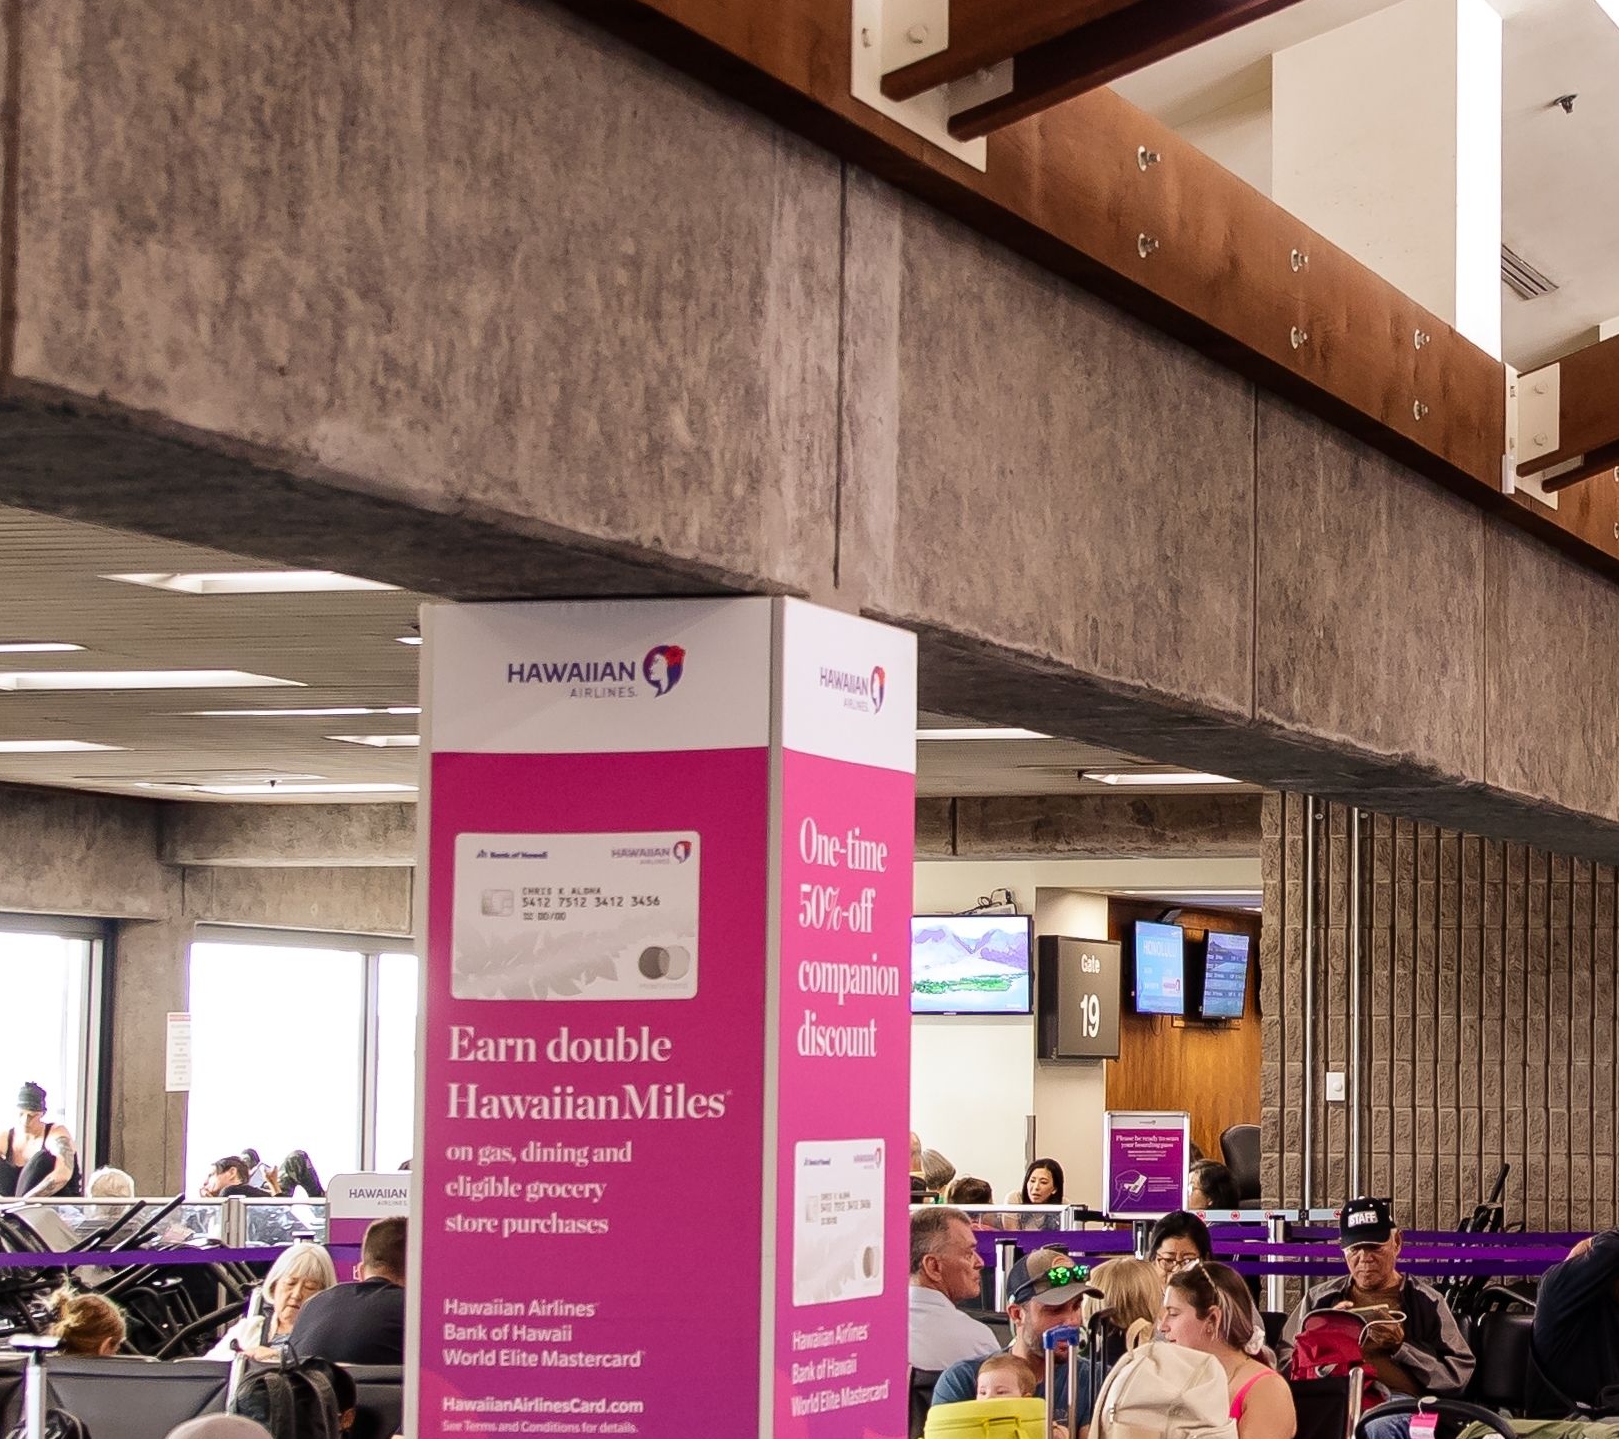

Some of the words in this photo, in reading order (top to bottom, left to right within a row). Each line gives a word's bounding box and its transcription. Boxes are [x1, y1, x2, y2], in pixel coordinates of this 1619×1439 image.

[507, 662, 636, 683] HAWAIIAN
[819, 666, 869, 696] HAWAIIAN
[570, 687, 636, 699] AIRLINES
[799, 817, 888, 873] One-time
[522, 897, 551, 907] 5412
[558, 897, 587, 907] 7512
[594, 896, 624, 907] 3412
[631, 896, 660, 907] 3456
[798, 883, 875, 933] 50%-off
[1081, 953, 1100, 974] Gate
[798, 954, 899, 1006] companion
[1080, 994, 1101, 1038] 19
[448, 1025, 537, 1062] Earn
[546, 1026, 673, 1063] double
[797, 1010, 877, 1058] discount
[445, 1145, 473, 1161] on
[478, 1145, 517, 1165] gas,
[521, 1141, 590, 1167] dining
[593, 1141, 632, 1162] and
[349, 1189, 407, 1198] HAWAIIAN
[445, 1176, 522, 1201] eligible
[526, 1182, 607, 1203] grocery
[445, 1213, 498, 1233] store
[502, 1213, 609, 1238] purchases
[1348, 1209, 1379, 1229] STAFF
[443, 1299, 524, 1316] Hawaiian
[528, 1299, 596, 1317] Airlines
[443, 1323, 488, 1341] Bank
[490, 1324, 511, 1341] of
[512, 1325, 573, 1342] Hawaii
[792, 1326, 835, 1351] Hawaiian
[442, 1349, 496, 1366] World
[500, 1349, 539, 1367] Elite
[541, 1350, 642, 1368] Mastercard
[792, 1362, 815, 1385] Bank
[816, 1358, 827, 1380] of
[827, 1353, 857, 1378] Hawaii
[442, 1397, 644, 1413] HawaiianAirlinesCard.com
[791, 1392, 819, 1417] World
[820, 1390, 840, 1412] Elite
[442, 1421, 463, 1432] See
[464, 1421, 497, 1432] Terms
[498, 1421, 519, 1432] and
[521, 1421, 580, 1433] Conditions
[581, 1422, 597, 1433] for
[599, 1422, 639, 1433] details.
